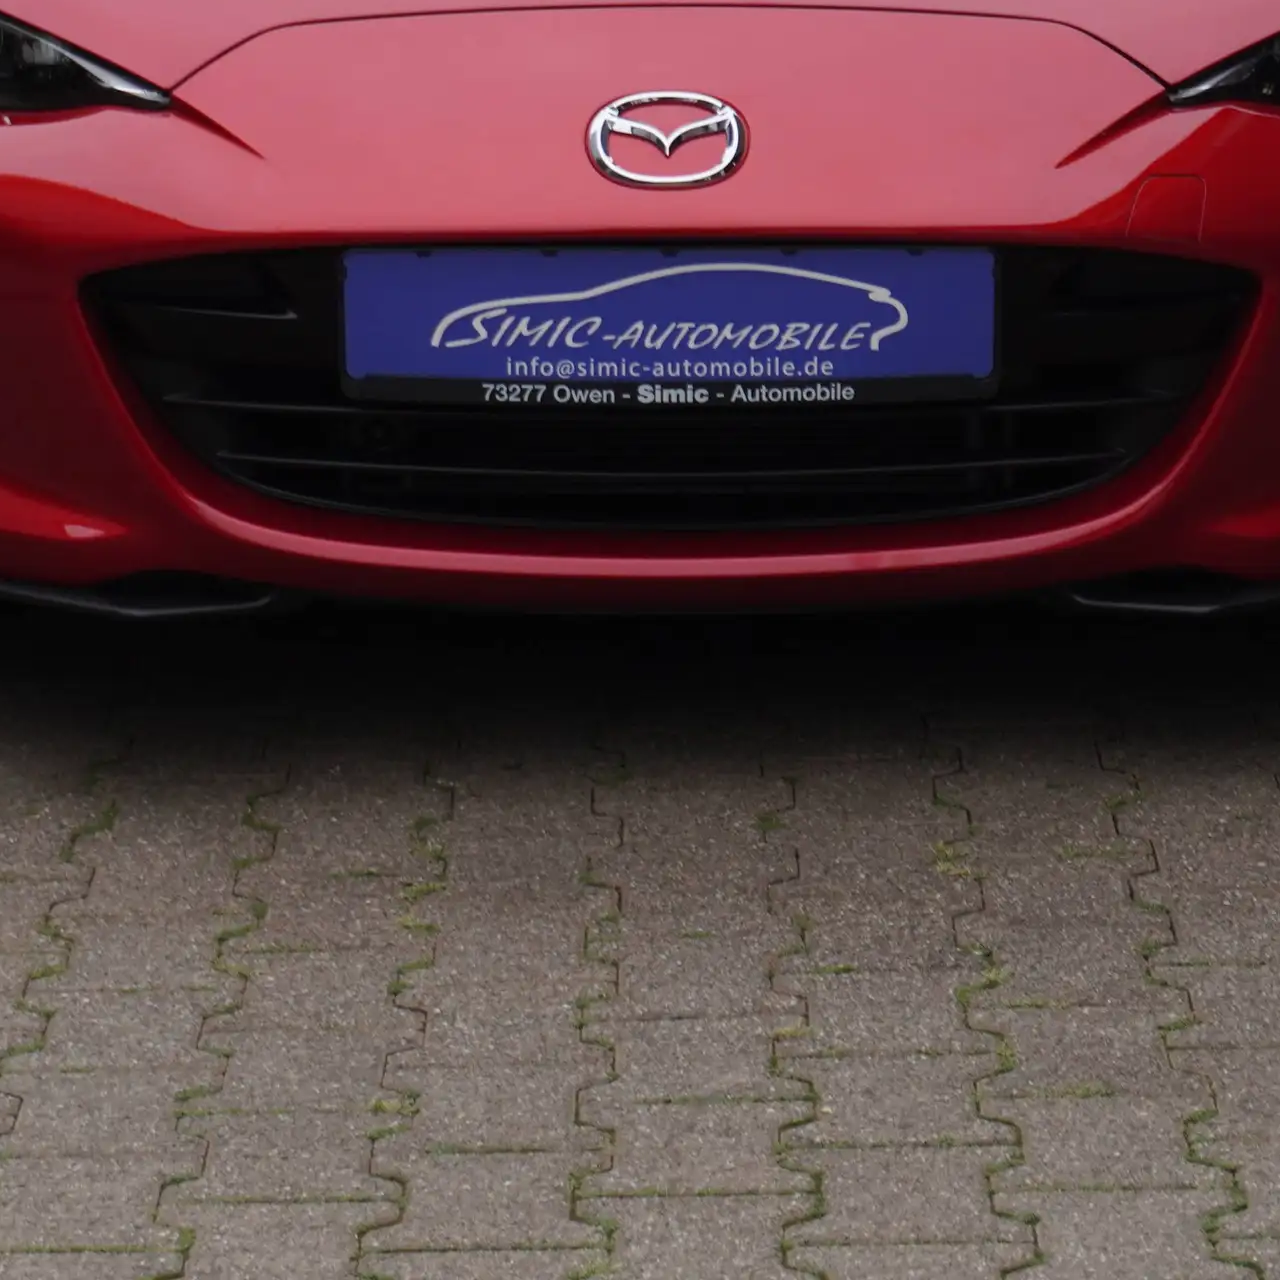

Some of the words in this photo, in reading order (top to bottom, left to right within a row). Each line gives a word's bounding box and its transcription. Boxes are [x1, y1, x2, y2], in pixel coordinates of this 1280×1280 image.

[505, 356, 835, 380] info@simic-automobile.de
[482, 384, 547, 403] 73277
[553, 384, 616, 404] Owen
[637, 384, 709, 404] Simic
[730, 382, 856, 404] Automobile
